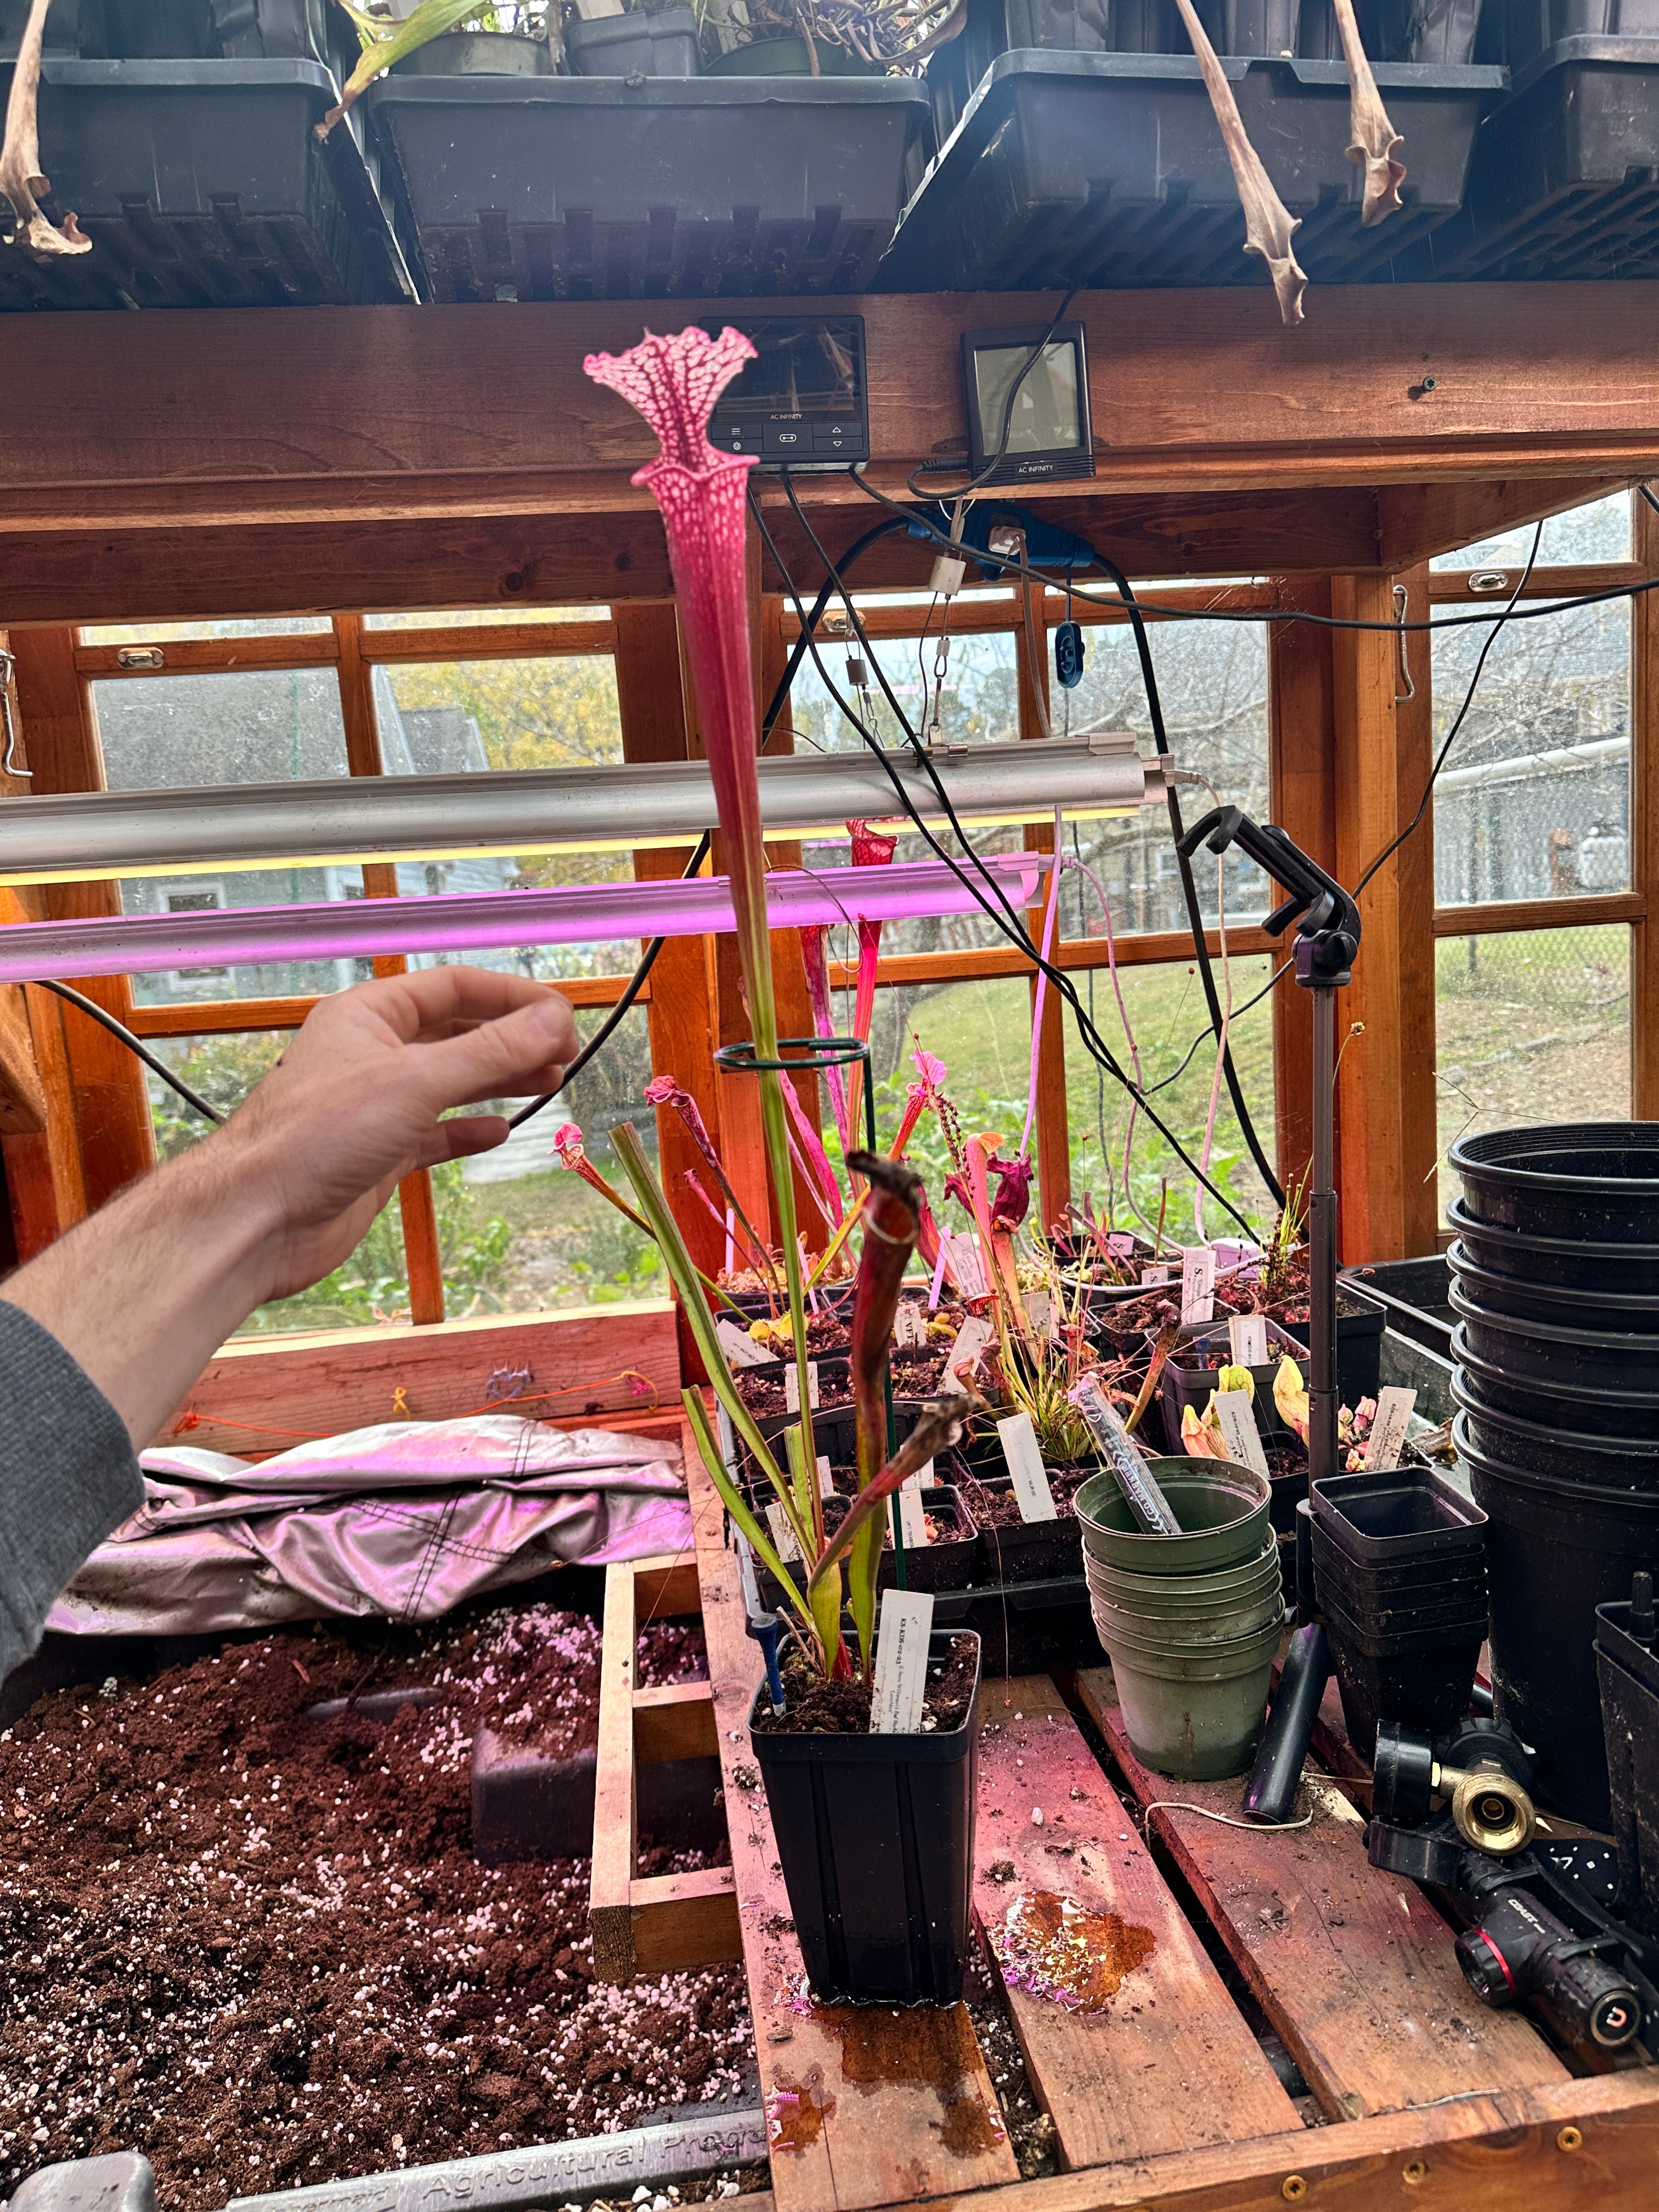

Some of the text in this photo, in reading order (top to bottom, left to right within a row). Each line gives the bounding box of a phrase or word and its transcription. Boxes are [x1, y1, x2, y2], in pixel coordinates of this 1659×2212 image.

[895, 1618, 907, 1664] KS-KDS-02-23
[1508, 1899, 1538, 1923] COAST
[422, 2137, 646, 2199] Agricultural
